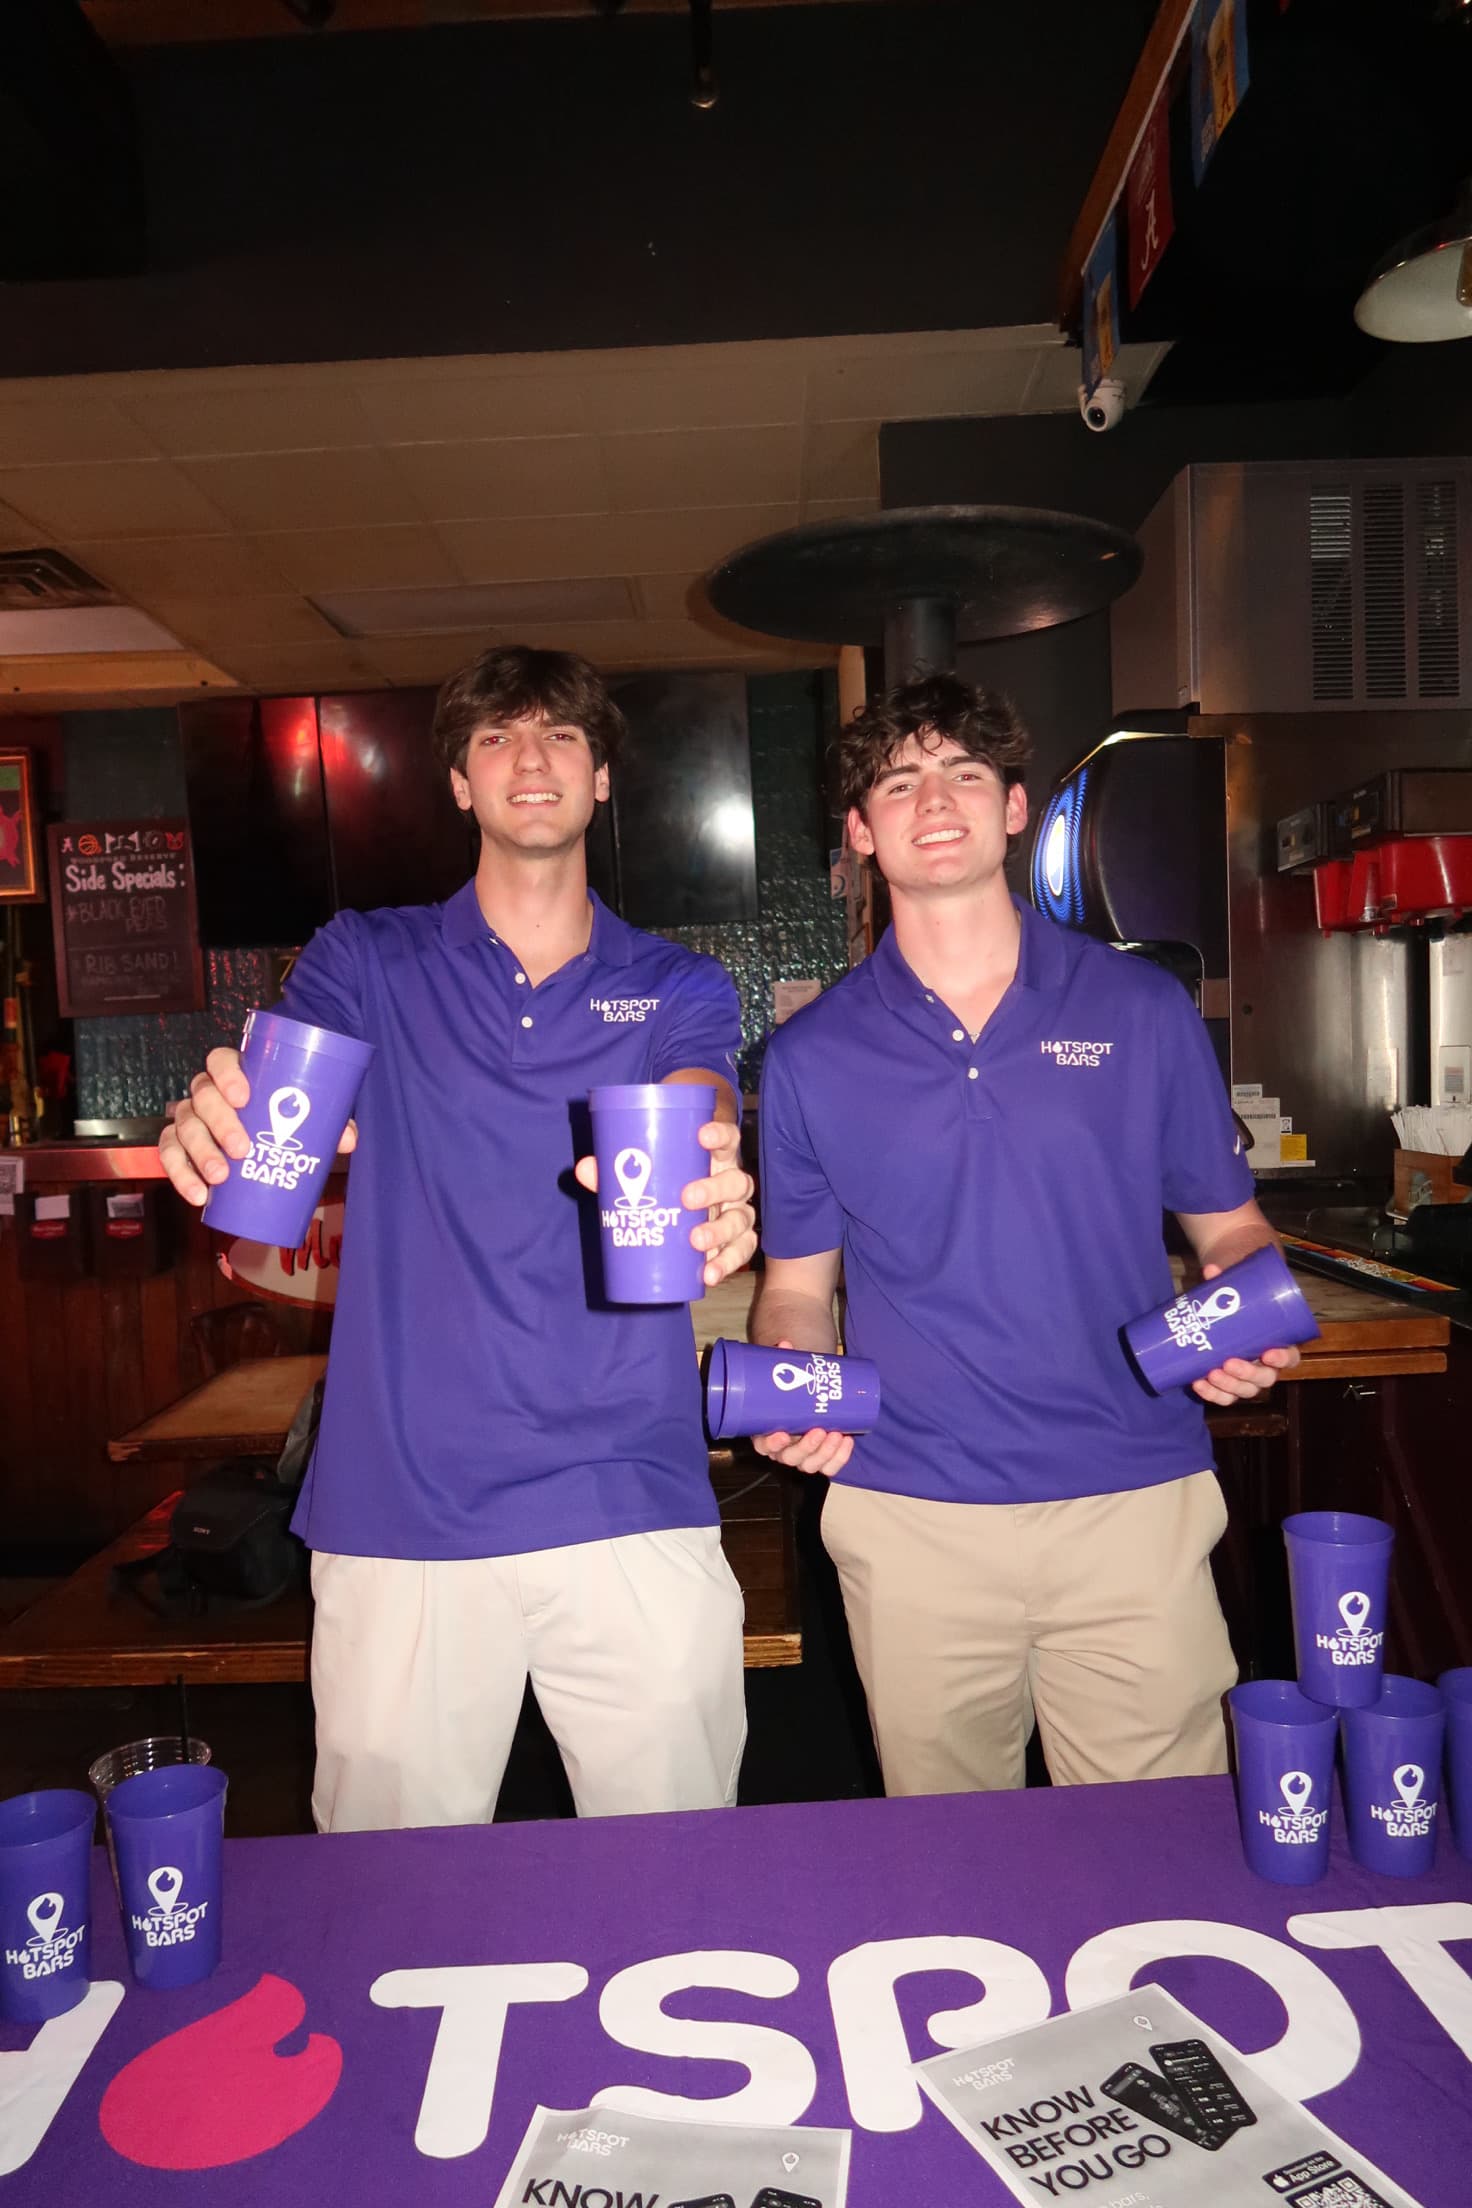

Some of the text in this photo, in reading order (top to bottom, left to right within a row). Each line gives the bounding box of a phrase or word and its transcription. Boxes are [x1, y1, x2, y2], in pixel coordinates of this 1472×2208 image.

[65, 864, 106, 892] Side
[590, 998, 660, 1012] HOTSPOT
[603, 1011, 646, 1022] BARS
[1041, 1041, 1114, 1055] HOTSPOT
[1056, 1053, 1100, 1067] BARS
[241, 1159, 299, 1190] BARS
[602, 1208, 681, 1228] HOTSPOT
[613, 1227, 664, 1247] BARS
[1164, 1307, 1192, 1347] BARS
[827, 1361, 843, 1400] BARS
[1316, 1632, 1384, 1651] HOTSPOT
[1332, 1650, 1375, 1665] BARS
[1259, 1810, 1328, 1829] HOTSPOT
[1371, 1802, 1437, 1822] HOTSPOT
[1274, 1828, 1319, 1844] BARS
[1386, 1820, 1430, 1837] BARS
[132, 1902, 208, 1932] HOTSPOT
[5, 1925, 86, 1965] HOTSPOT
[146, 1924, 196, 1947] BARS
[23, 1950, 74, 1980] BARS
[972, 2071, 1013, 2091] BARS
[981, 2085, 1095, 2141] KNOW
[1004, 2108, 1138, 2168] BEFORE
[1029, 2134, 1171, 2197] YOU GO
[1290, 2170, 1310, 2183] App
[1307, 2160, 1335, 2175] Store
[522, 2178, 659, 2208] KNOW
